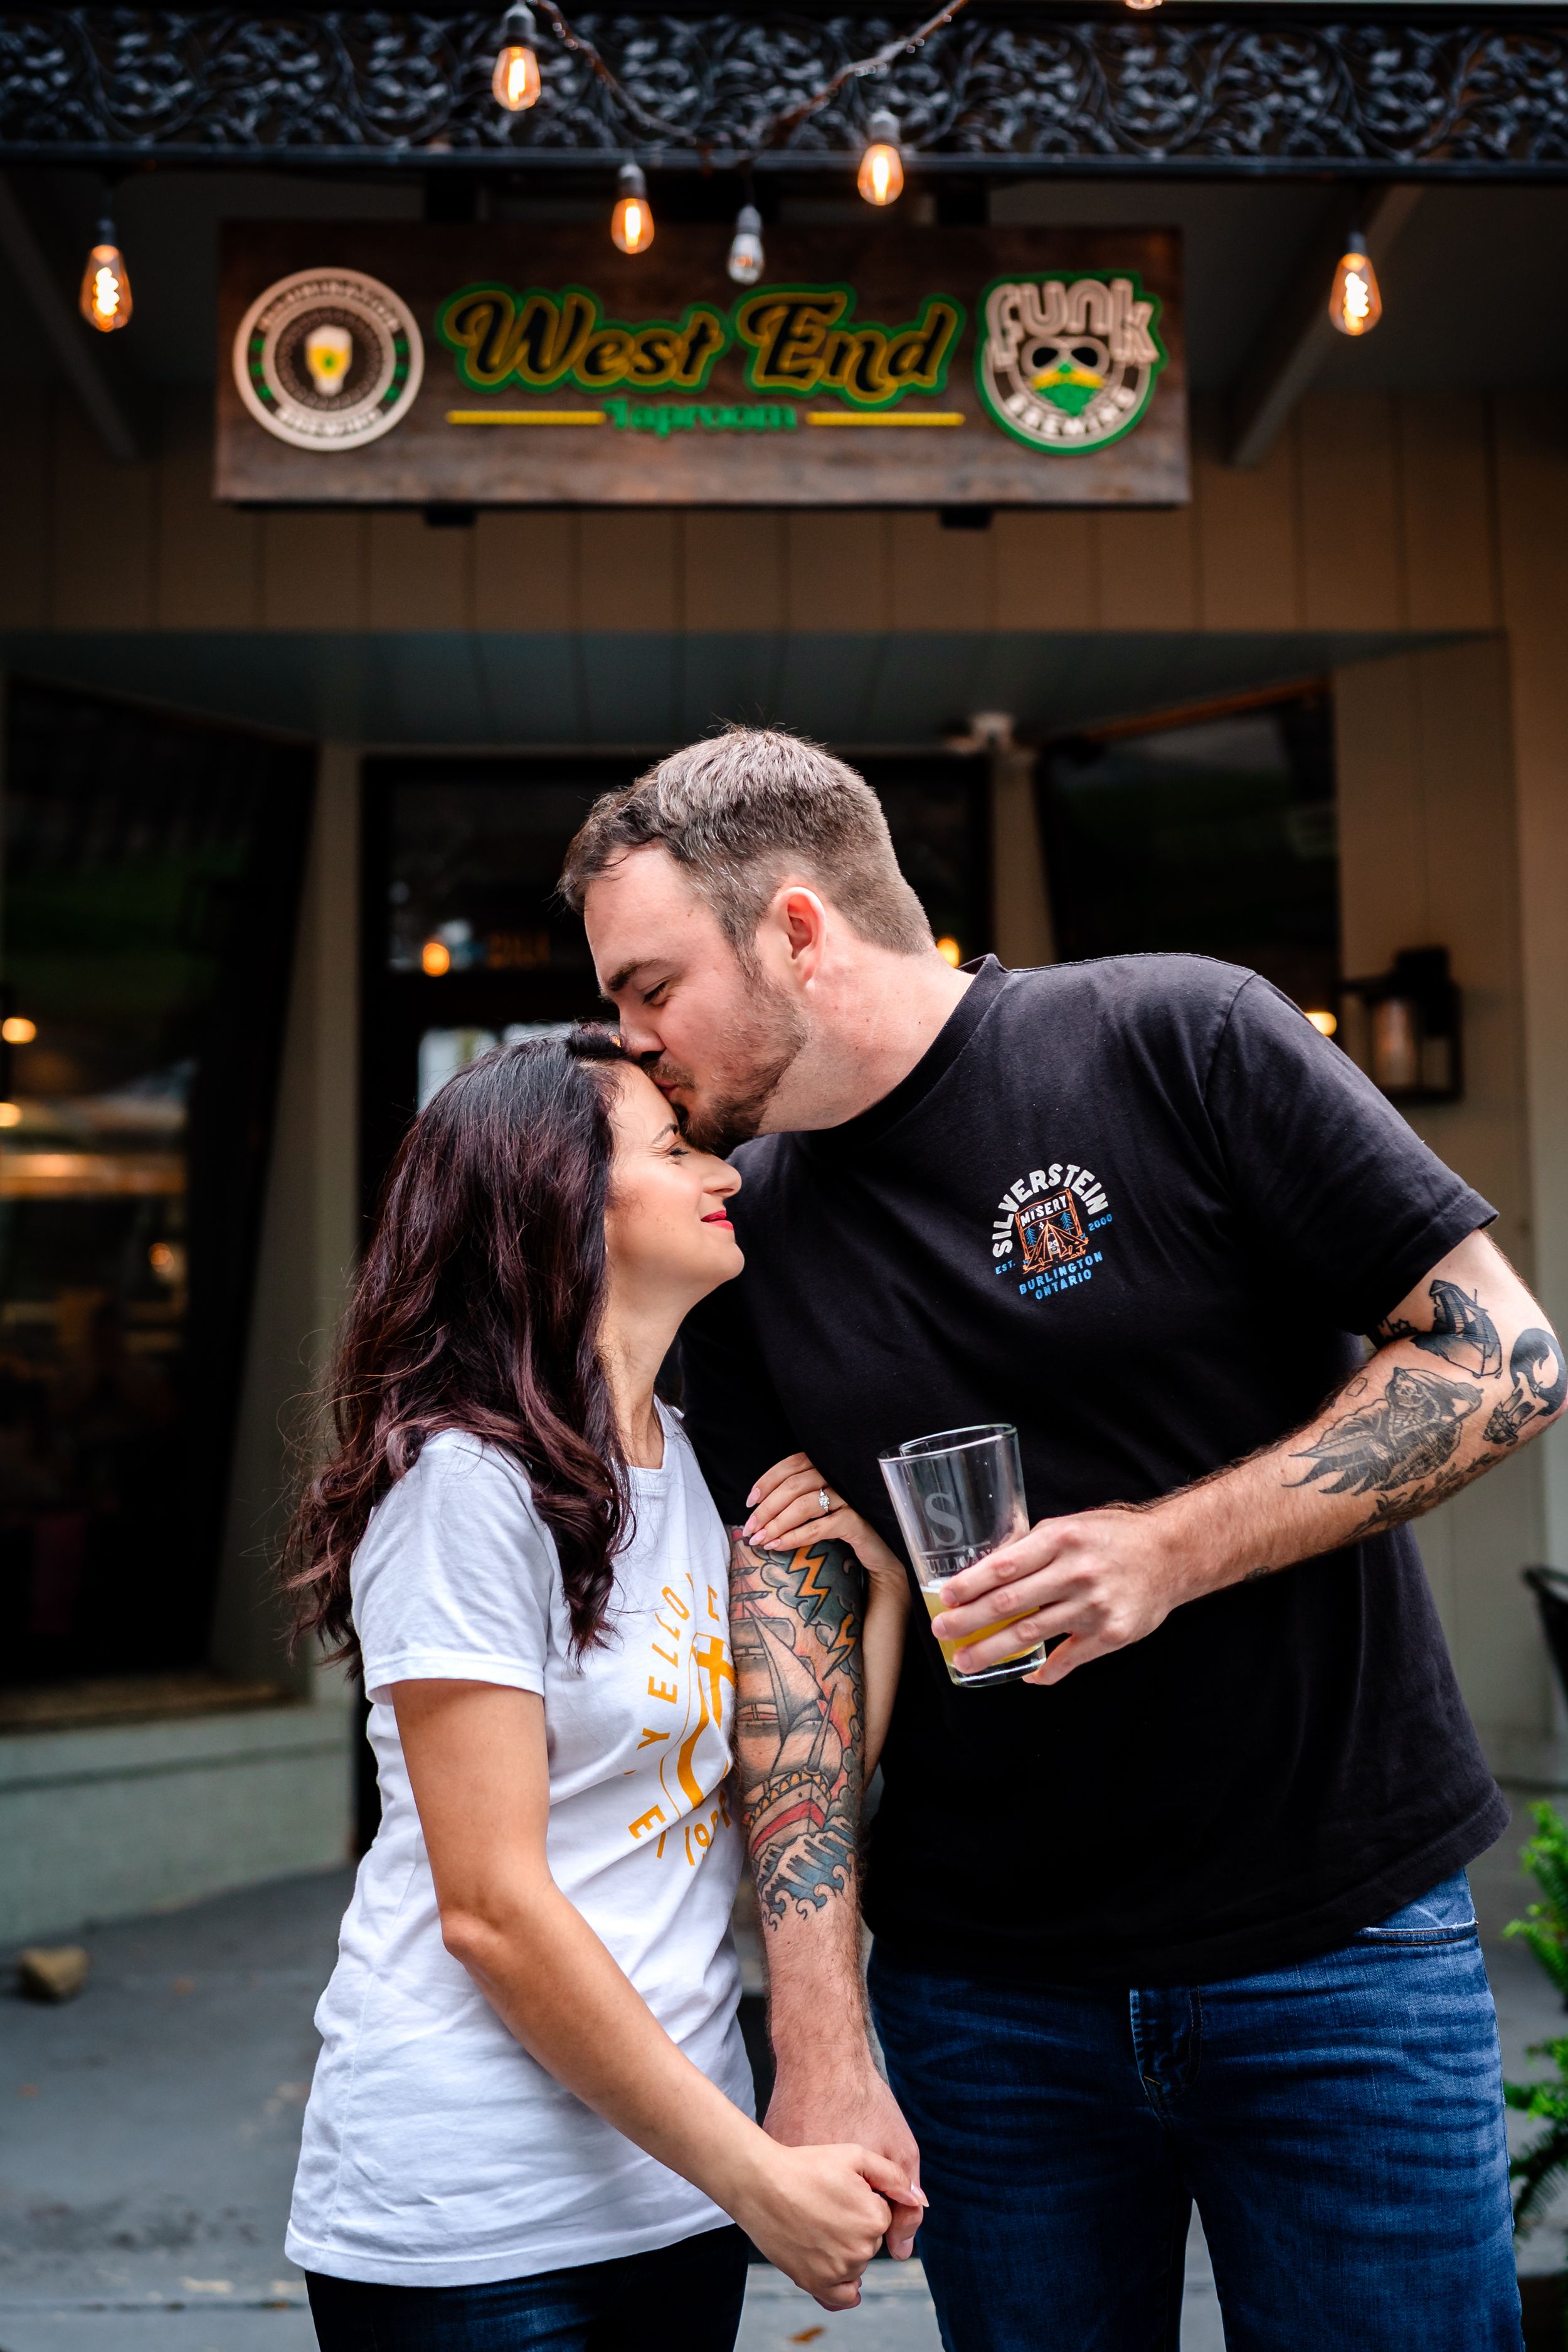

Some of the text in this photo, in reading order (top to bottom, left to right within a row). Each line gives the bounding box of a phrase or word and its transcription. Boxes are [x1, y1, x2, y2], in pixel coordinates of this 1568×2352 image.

[442, 289, 726, 388] West
[736, 290, 958, 403] End
[992, 1163, 1109, 1258] SILVERSTEIN
[1020, 1195, 1067, 1227] MISERY
[995, 1213, 1113, 1275] EST. 2000
[1019, 1251, 1103, 1295] BURLINGTON
[1035, 1269, 1092, 1300] ONTARIO
[924, 1492, 963, 1549] S
